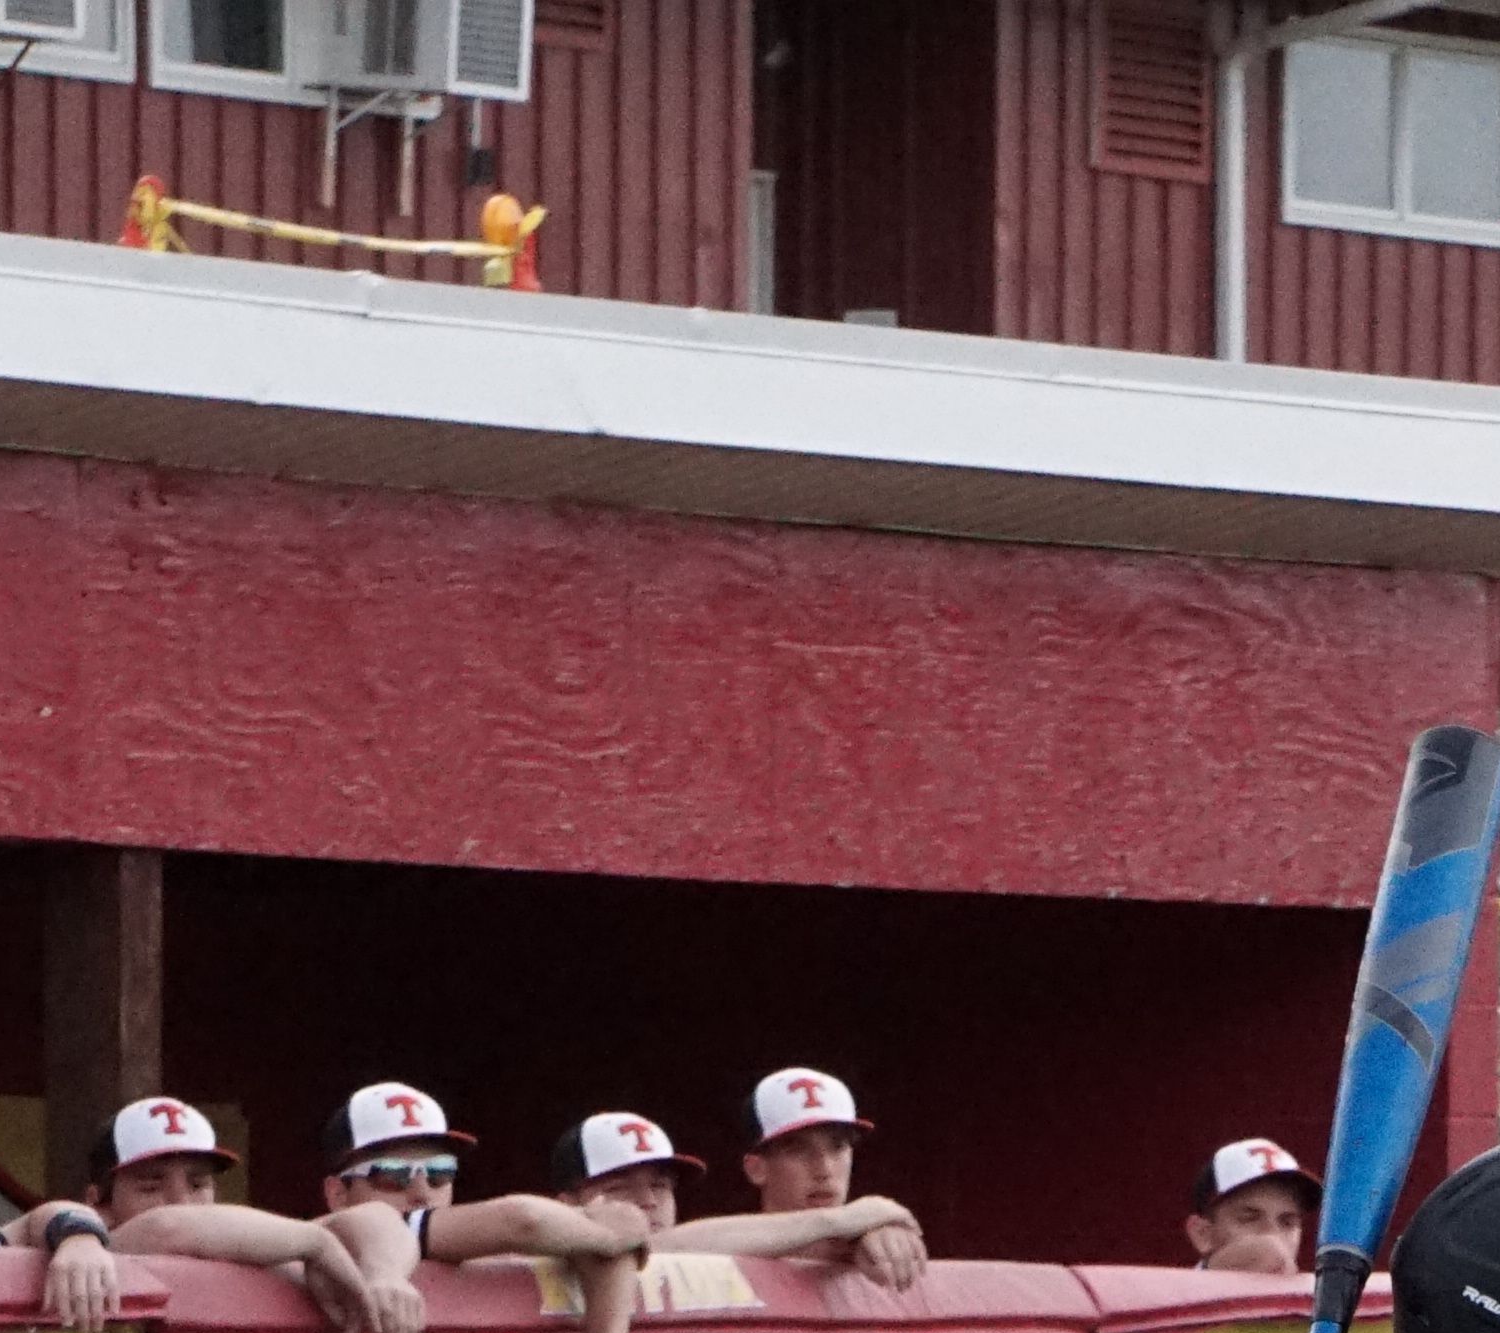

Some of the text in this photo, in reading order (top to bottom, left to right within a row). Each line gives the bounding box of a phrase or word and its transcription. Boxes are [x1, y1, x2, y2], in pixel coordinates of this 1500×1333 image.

[789, 1078, 823, 1109] T
[149, 1102, 186, 1134] T
[386, 1094, 422, 1127] T
[618, 1121, 653, 1152] T
